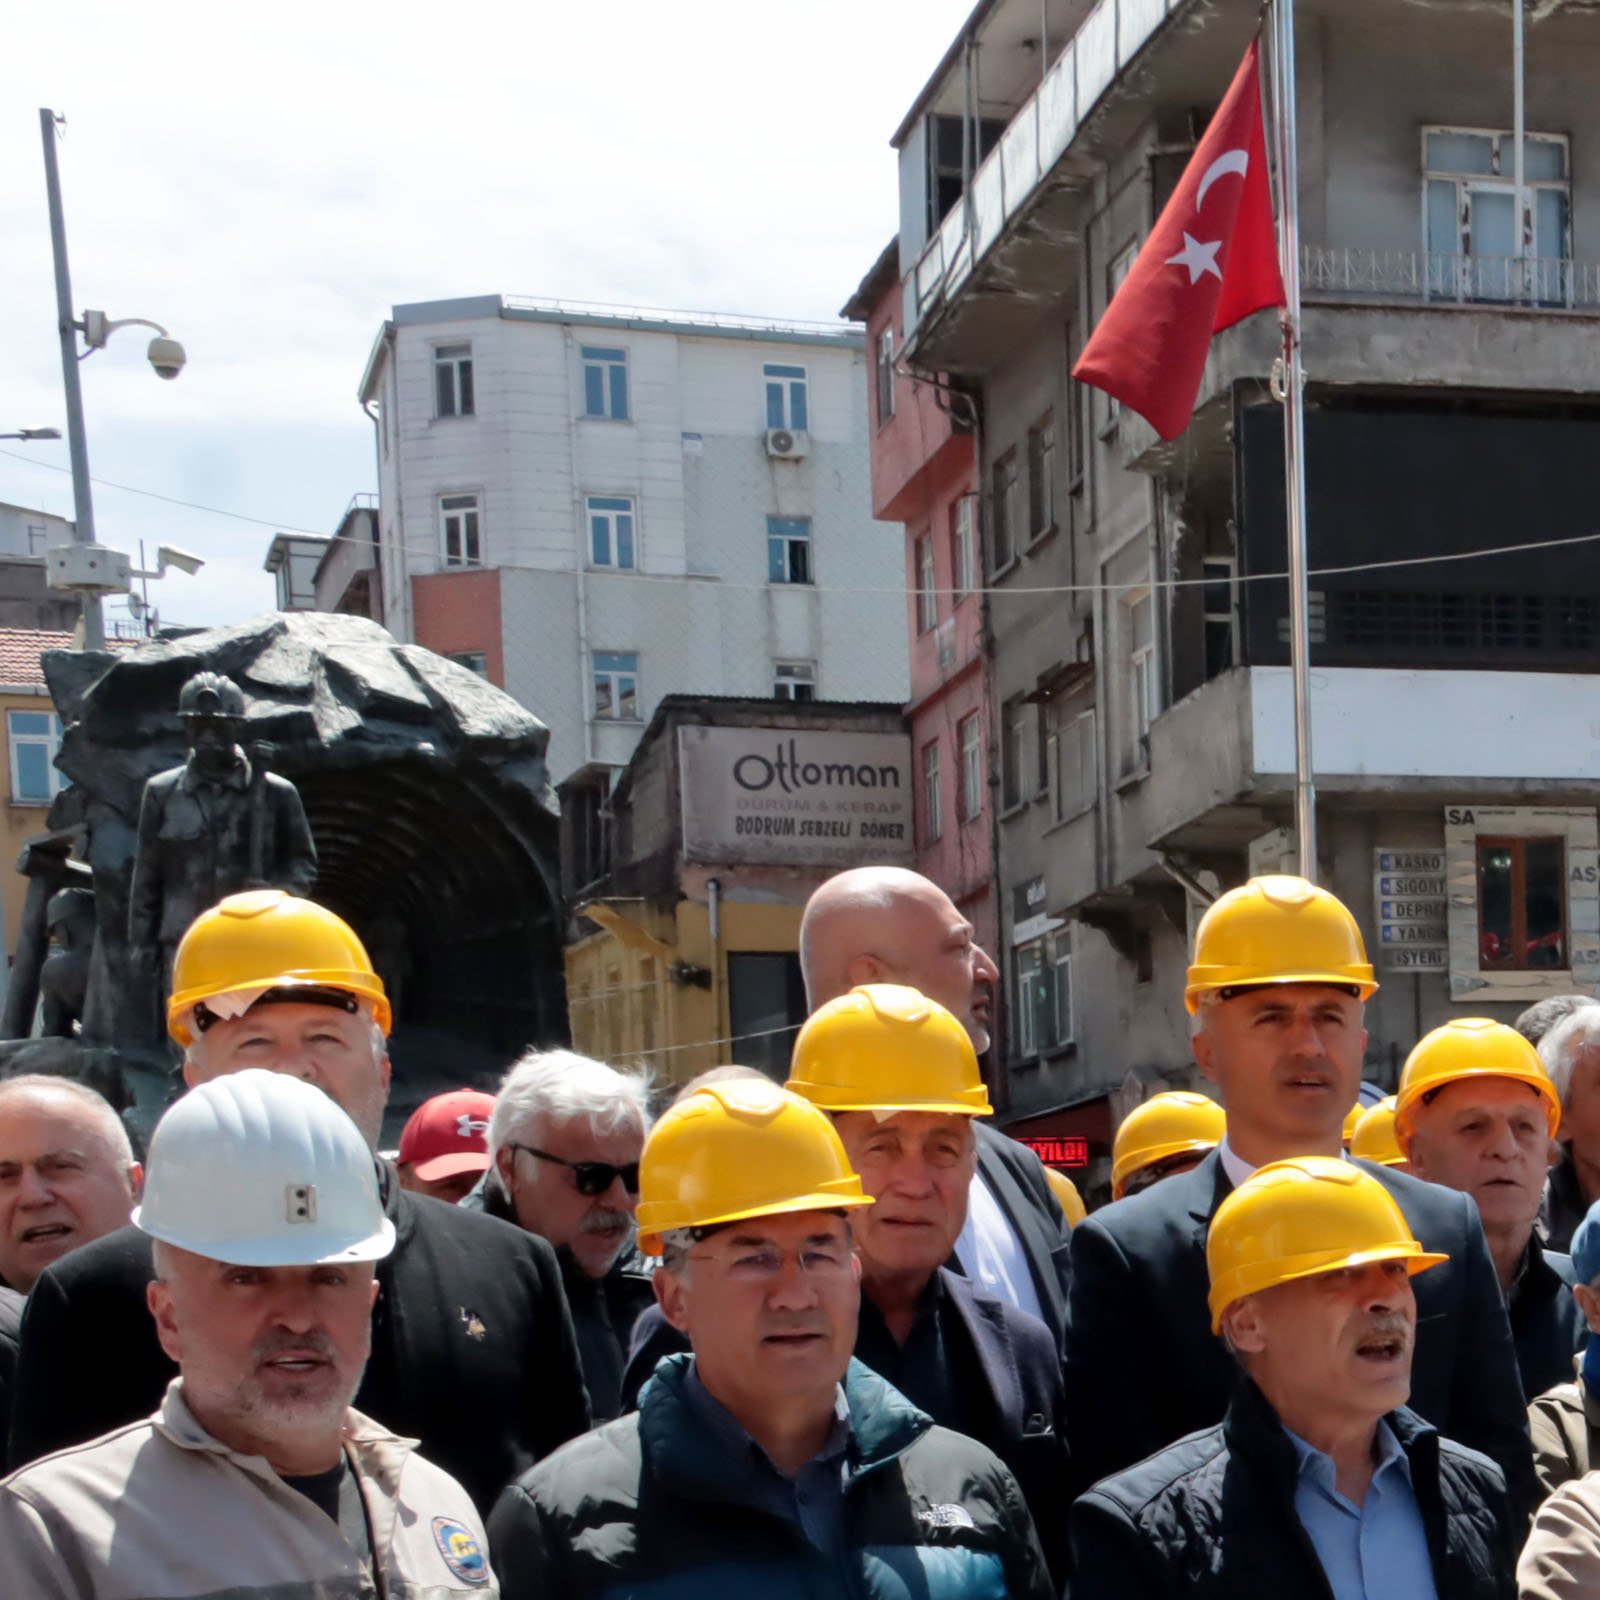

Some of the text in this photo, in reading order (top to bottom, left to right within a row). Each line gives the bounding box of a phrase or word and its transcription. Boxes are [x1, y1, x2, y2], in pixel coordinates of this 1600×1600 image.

[733, 738, 900, 794] Ottoman
[735, 815, 795, 837] BODRUM
[859, 818, 905, 840] DÖNER
[1393, 854, 1441, 871] KASKO
[1395, 877, 1447, 894] SİGORT
